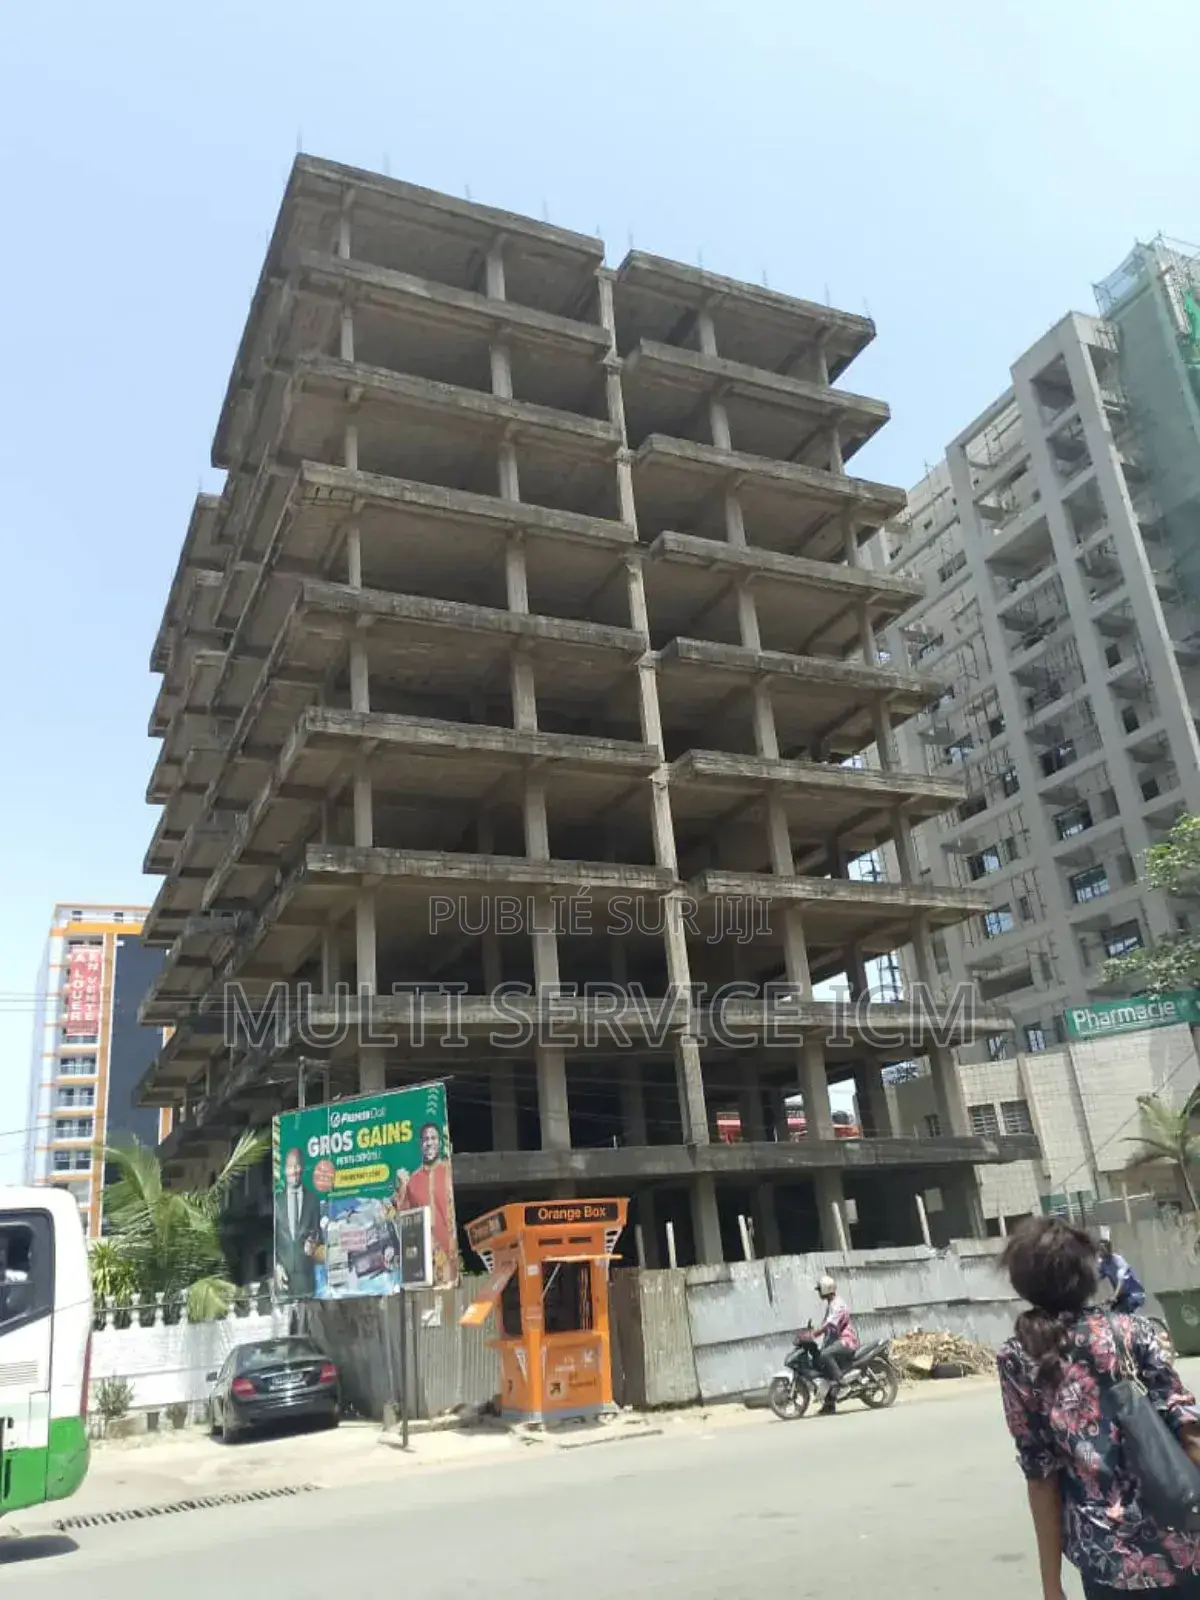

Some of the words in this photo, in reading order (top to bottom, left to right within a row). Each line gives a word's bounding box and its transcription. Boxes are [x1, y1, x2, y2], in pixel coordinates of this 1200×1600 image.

[1072, 1000, 1176, 1031] Pharmacie
[308, 1130, 354, 1157] GROS
[357, 1120, 413, 1148] GAINS
[537, 1206, 582, 1220] Orange
[584, 1205, 607, 1218] Box
